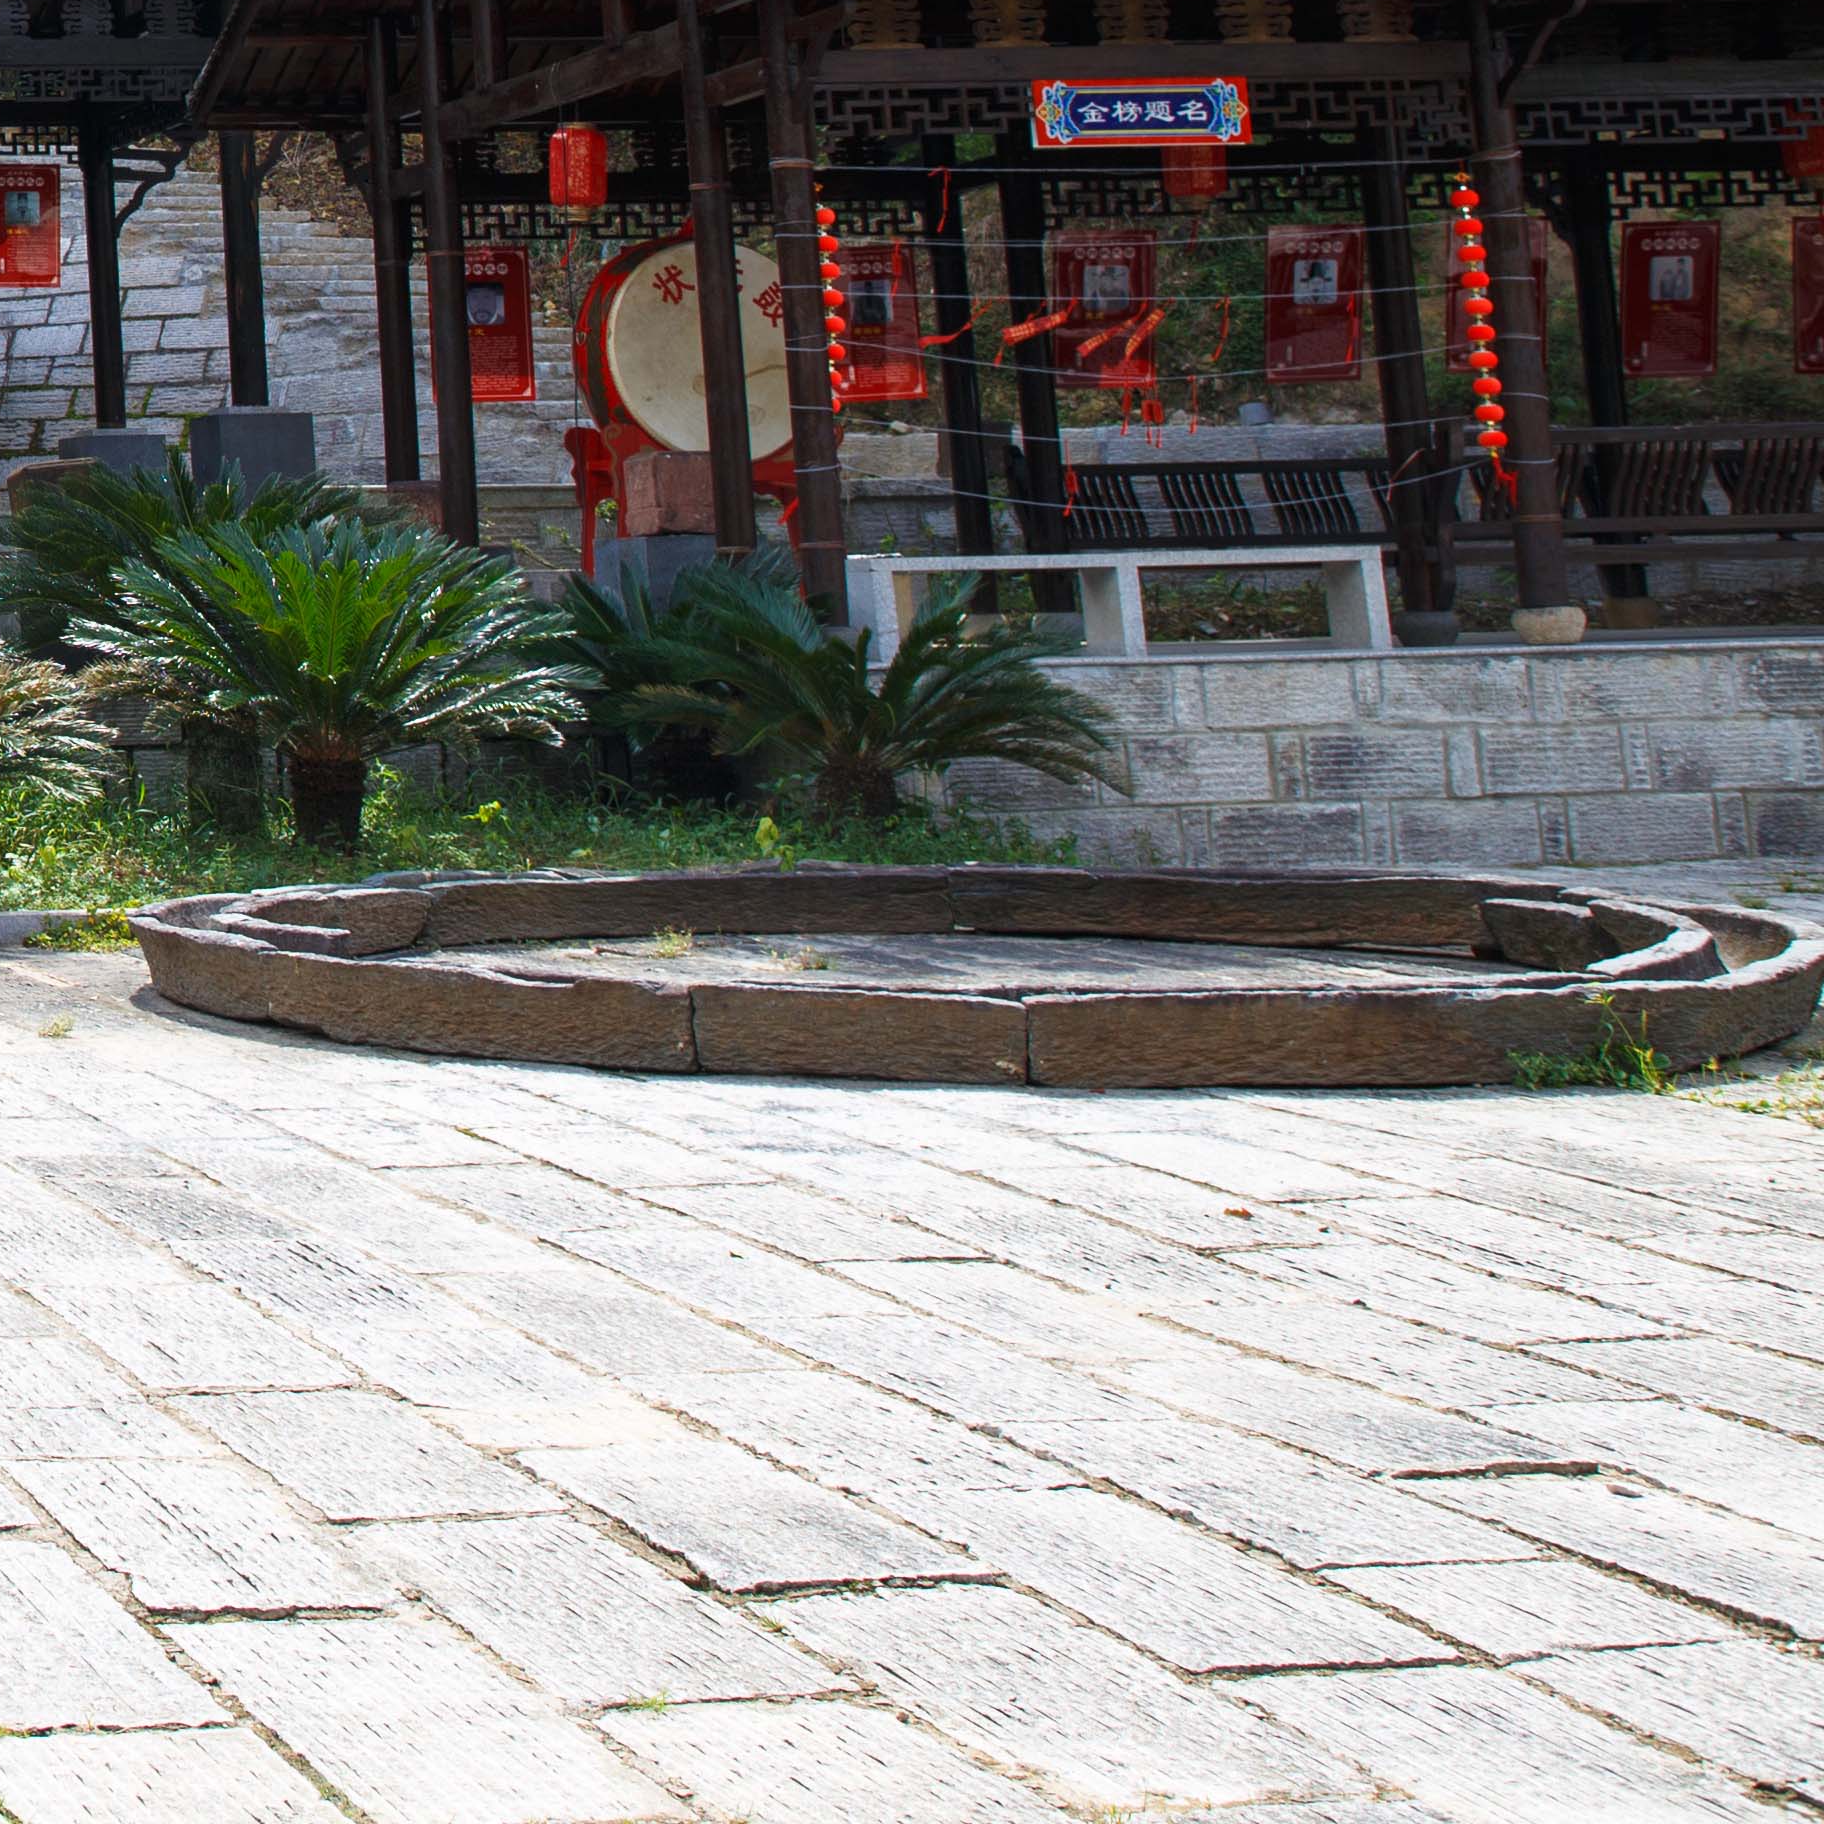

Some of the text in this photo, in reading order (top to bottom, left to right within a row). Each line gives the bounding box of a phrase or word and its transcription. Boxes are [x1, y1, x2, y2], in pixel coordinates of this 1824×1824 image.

[1077, 99, 1208, 124] 金榜题名
[652, 264, 783, 328] 状鼓
